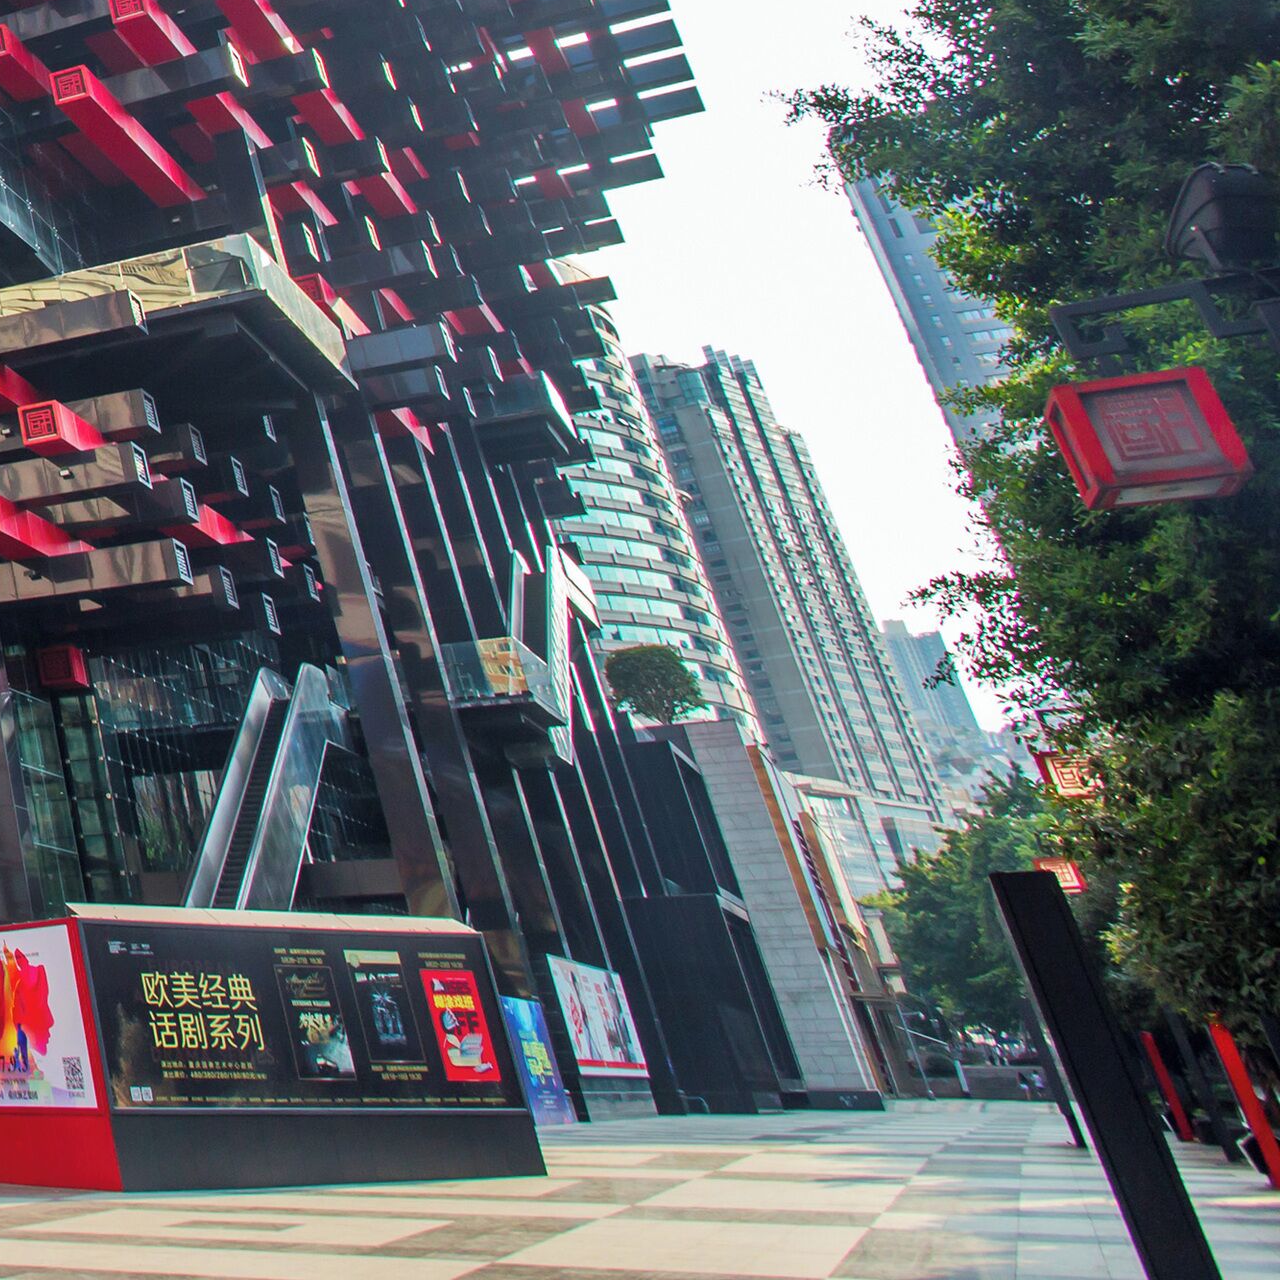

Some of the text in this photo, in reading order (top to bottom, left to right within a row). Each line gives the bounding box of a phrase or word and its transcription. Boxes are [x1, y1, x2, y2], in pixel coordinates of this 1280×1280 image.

[140, 970, 258, 1011] 欧美经典
[148, 1009, 266, 1051] 话剧系列
